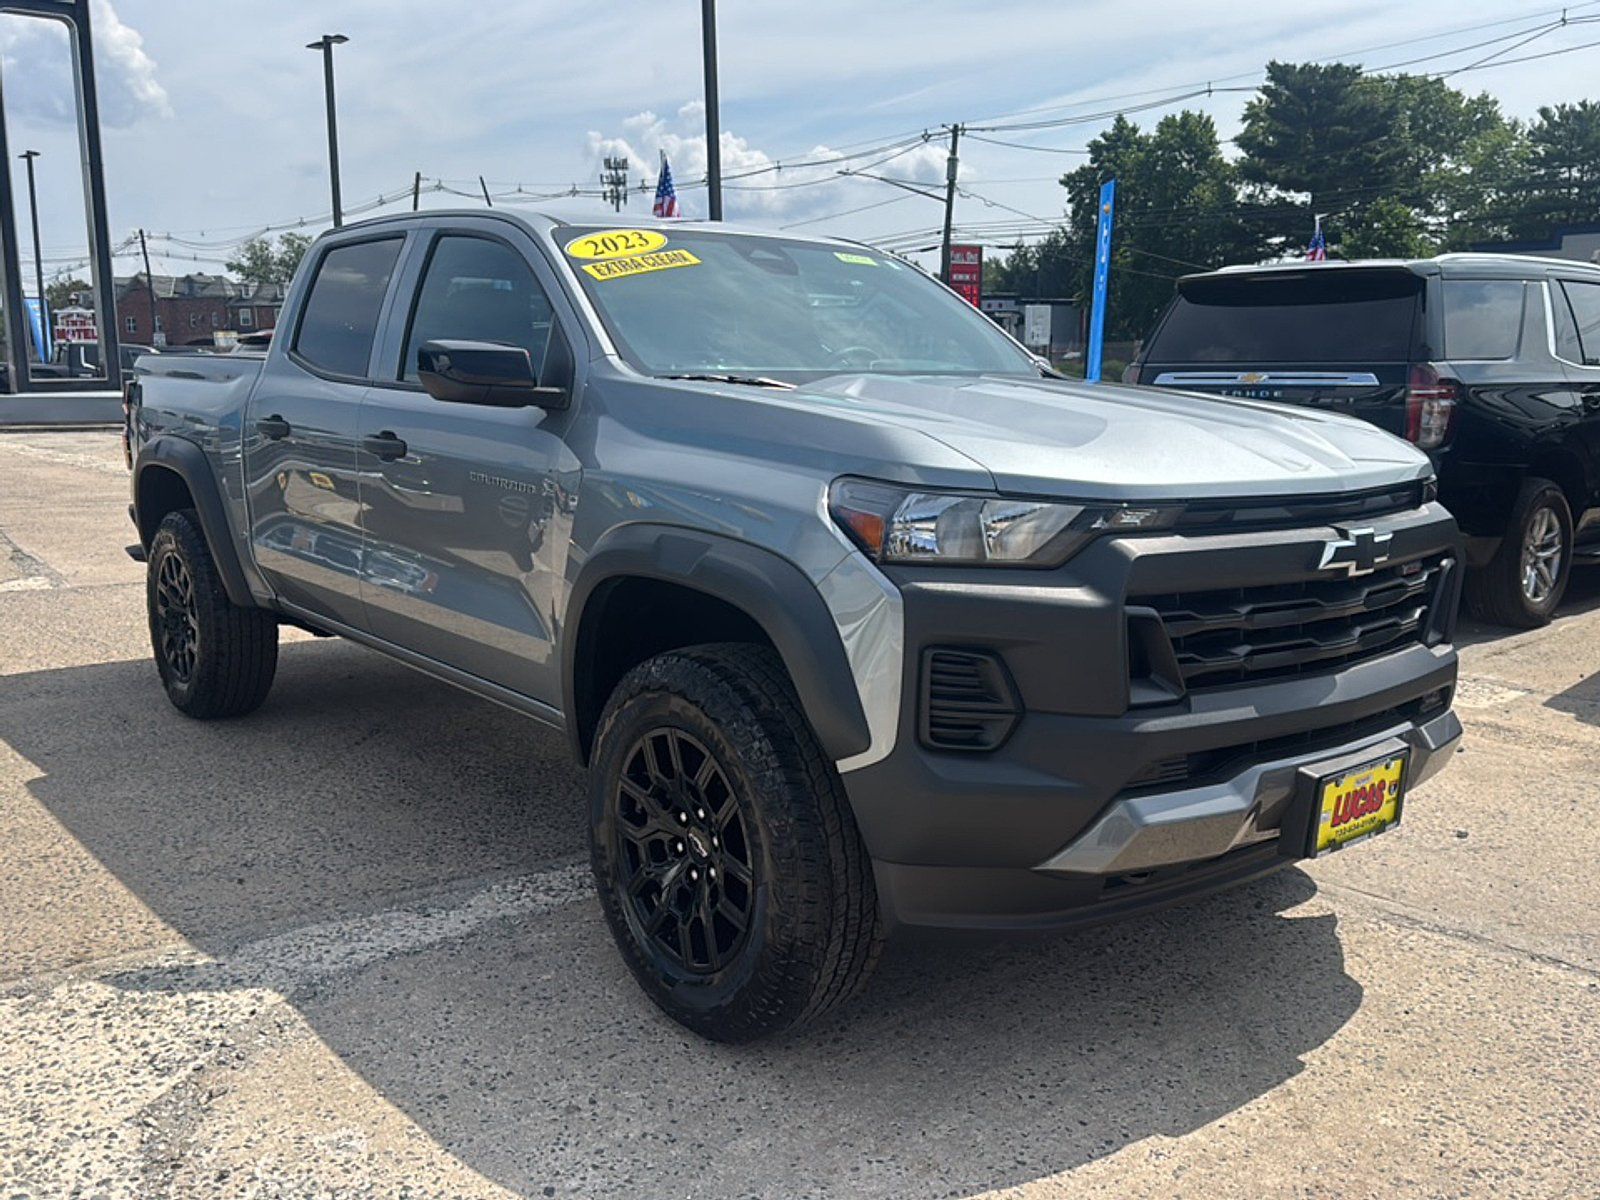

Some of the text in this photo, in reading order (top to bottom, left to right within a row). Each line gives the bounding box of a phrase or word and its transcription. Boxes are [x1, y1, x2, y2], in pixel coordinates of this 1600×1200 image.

[585, 231, 650, 256] 2023
[591, 252, 692, 277] EXTRA CLEAN
[1221, 390, 1282, 398] TAHOE
[470, 471, 536, 493] COLORADO
[1330, 779, 1386, 827] LUCAS
